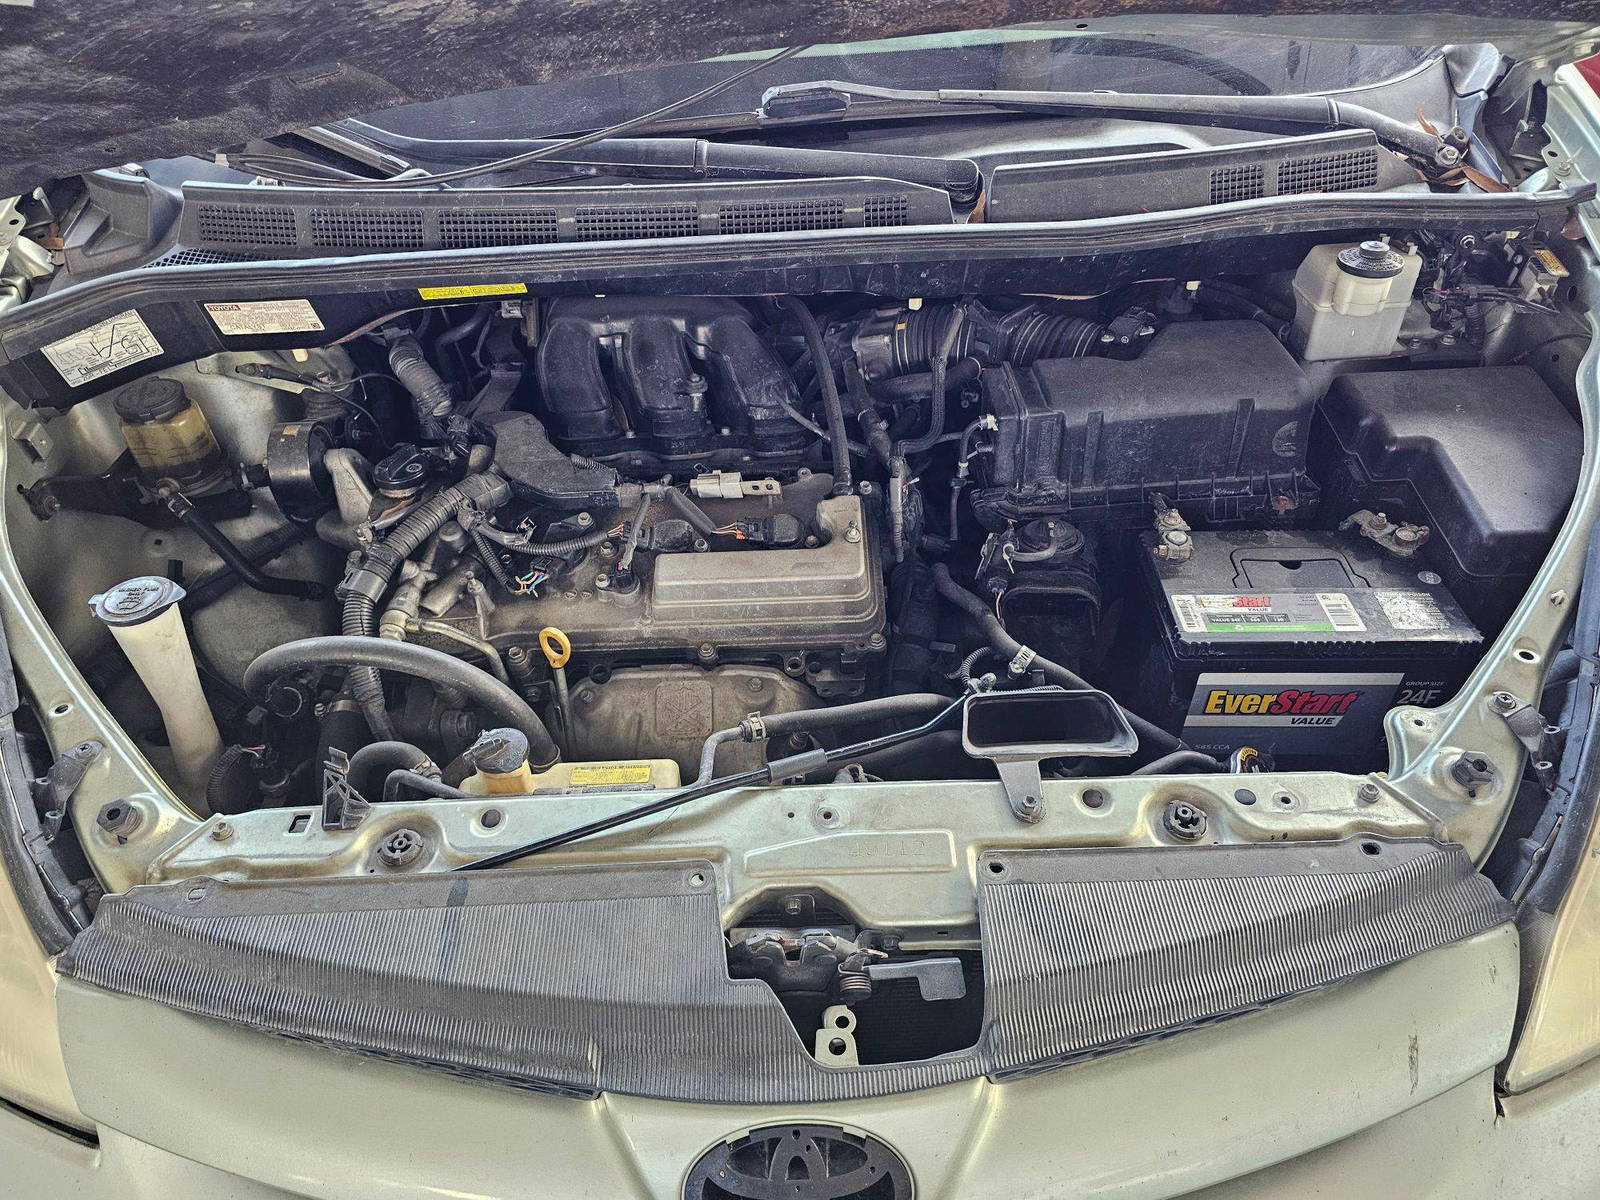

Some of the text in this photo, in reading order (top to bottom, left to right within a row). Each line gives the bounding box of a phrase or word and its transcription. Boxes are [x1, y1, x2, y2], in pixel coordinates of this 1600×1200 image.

[1204, 689, 1358, 715] EverStart
[1397, 689, 1440, 704] 24F
[1290, 717, 1336, 725] VALUE
